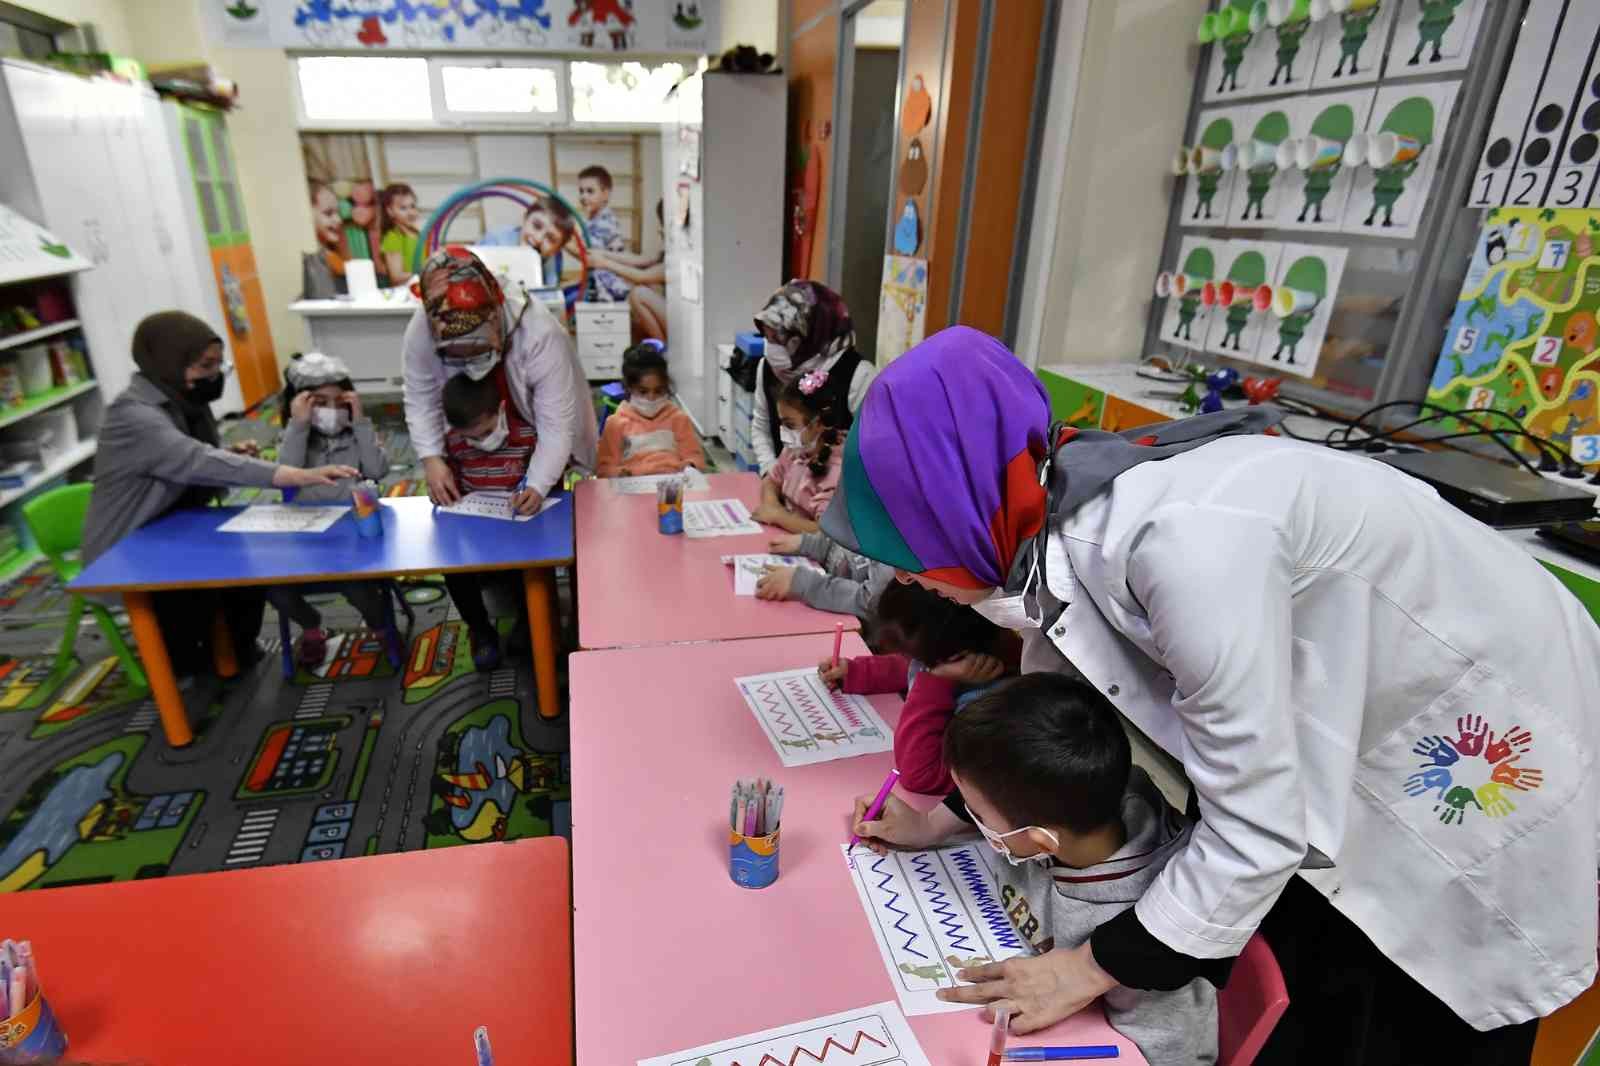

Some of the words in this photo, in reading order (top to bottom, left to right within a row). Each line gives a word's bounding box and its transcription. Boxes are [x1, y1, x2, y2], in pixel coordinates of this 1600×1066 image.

[1475, 172, 1494, 205] 1
[1512, 172, 1538, 205] 2
[1555, 170, 1583, 206] 3
[1550, 243, 1565, 268] 7
[1460, 329, 1475, 351] 5
[1537, 339, 1557, 363] 2
[1580, 437, 1599, 461] 3
